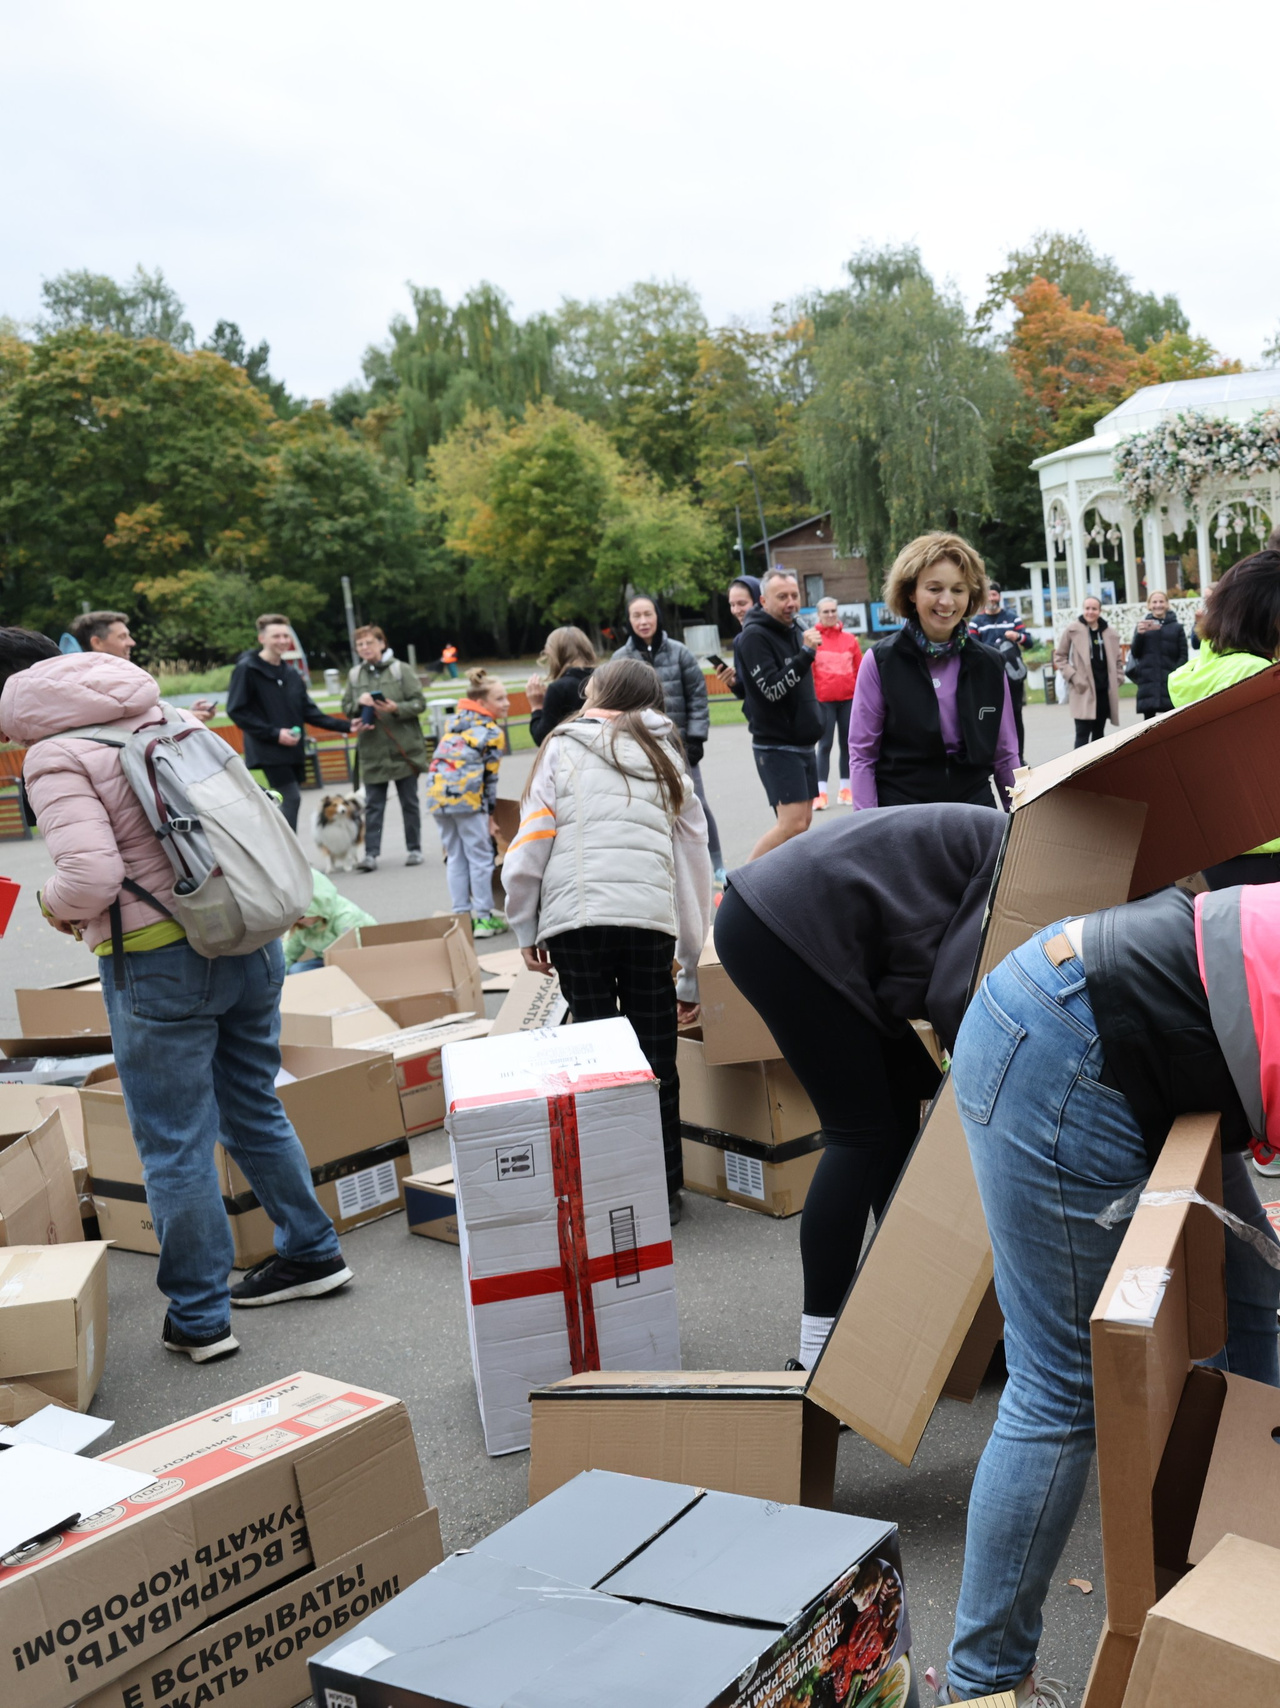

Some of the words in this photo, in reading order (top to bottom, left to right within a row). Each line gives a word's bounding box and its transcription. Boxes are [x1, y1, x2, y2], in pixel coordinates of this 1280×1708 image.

[522, 976, 554, 1026] РУЖАТЬ
[152, 1434, 238, 1473] СЛОЖЕНИЯ
[195, 1503, 305, 1568] УЖАТЬ
[290, 1526, 309, 1555] Е
[12, 1557, 191, 1673] КОРОБОМ!
[65, 1538, 284, 1683] ВСКРЫВАТЬ!
[811, 1610, 829, 1631] ДЕНЬ
[827, 1587, 855, 1616] КАЖДЫЙ
[122, 1683, 145, 1708] Е
[151, 1563, 366, 1701] ВСКРЫВАТЬ!
[254, 1574, 401, 1674] КОРОБОМ!
[790, 1628, 812, 1651] НОВЫЕ
[811, 1613, 841, 1647] НАШ
[752, 1641, 812, 1705] ТЕЛЕГРАМ
[759, 1647, 791, 1681] РЕЦЕПТЫ
